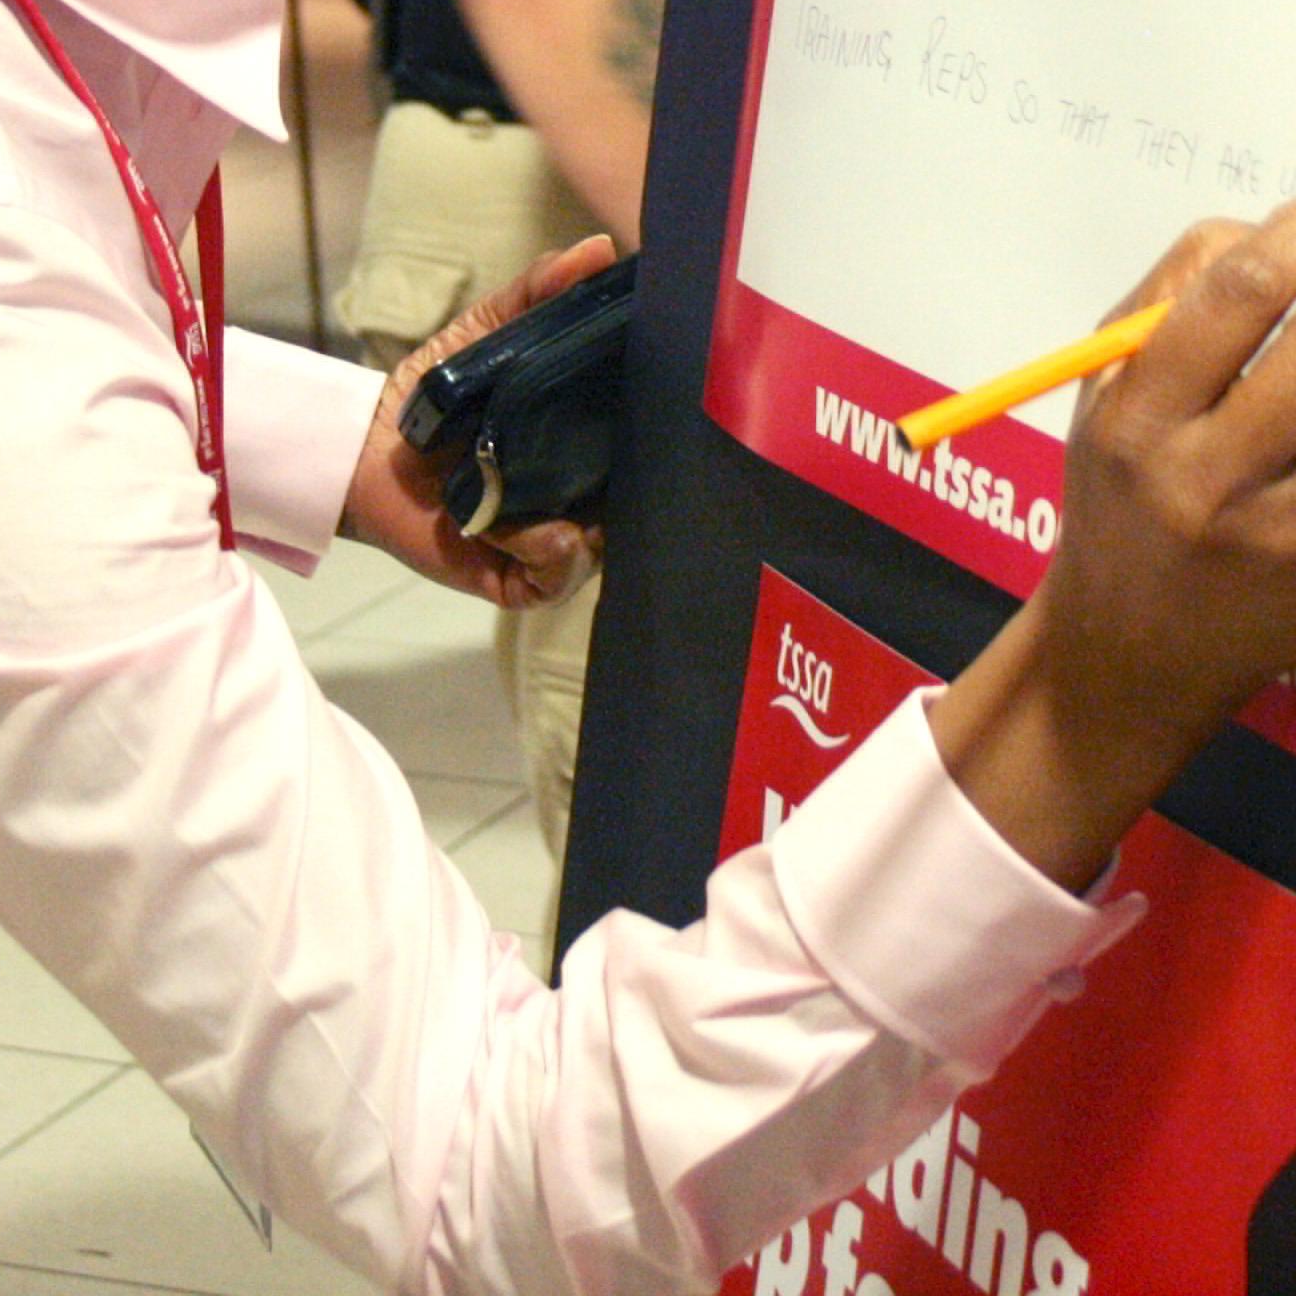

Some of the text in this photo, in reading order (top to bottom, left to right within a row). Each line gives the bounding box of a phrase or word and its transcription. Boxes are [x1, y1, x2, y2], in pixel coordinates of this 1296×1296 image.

[1133, 116, 1202, 186] THEY
[815, 384, 1062, 554] www.tssa.o
[777, 622, 833, 714] tssa
